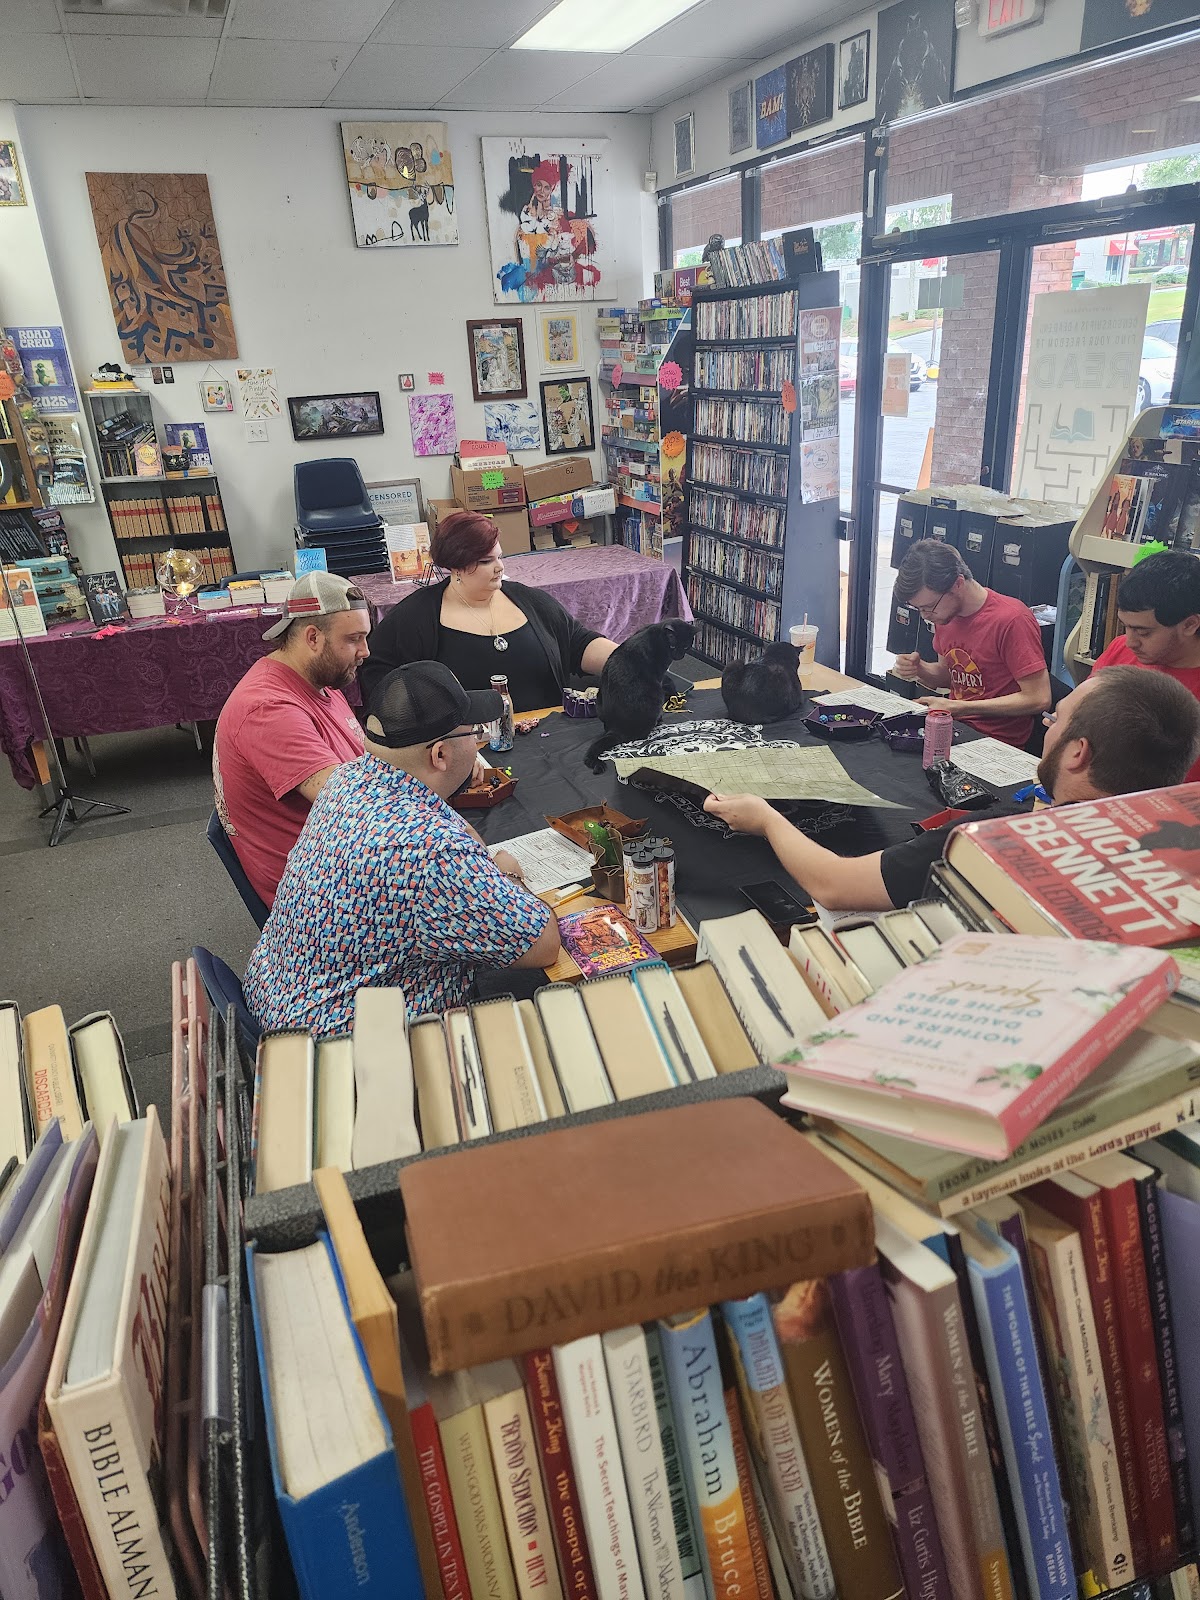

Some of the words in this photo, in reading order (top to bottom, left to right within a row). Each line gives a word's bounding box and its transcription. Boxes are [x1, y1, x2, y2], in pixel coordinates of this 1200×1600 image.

[760, 92, 784, 119] BAM!
[679, 277, 691, 287] Best
[18, 329, 51, 340] ROAD
[20, 339, 55, 349] CREW
[33, 396, 68, 407] 2025
[192, 453, 210, 461] RPG
[565, 466, 575, 475] 62
[369, 491, 413, 502] CENSORED
[300, 552, 320, 561] Bali
[300, 561, 322, 571] Blue
[949, 667, 983, 687] CAPERY
[989, 834, 1051, 882] MICHAEL
[1006, 815, 1176, 933] BENNETT
[904, 991, 961, 1006] BIBLE
[935, 979, 1057, 1010] Speak
[964, 999, 1008, 1013] THE
[1012, 1005, 1043, 1018] OF
[865, 1012, 911, 1027] AND
[893, 1003, 1022, 1030] DAUGHTERS
[914, 1020, 1023, 1046] MOTHERS
[901, 1034, 943, 1049] THE
[34, 1068, 53, 1122] DISCARDED
[938, 1171, 970, 1194] FROM
[1029, 1129, 1065, 1151] MOSES
[961, 1195, 970, 1206] a
[972, 1177, 1017, 1202] layman
[1019, 1163, 1051, 1184] looks
[1053, 1158, 1065, 1171] at
[1066, 1150, 1085, 1166] the
[1088, 1137, 1124, 1158] Lord's
[1124, 1121, 1162, 1147] prayer
[1146, 1202, 1161, 1264] GOSPEL
[503, 1267, 643, 1334] DAVID
[654, 1260, 700, 1297] the
[711, 1224, 817, 1283] KING
[1096, 1251, 1110, 1284] King
[1002, 1285, 1011, 1307] THE
[1155, 1280, 1168, 1321] MARY
[944, 1302, 963, 1370] WOMEN
[1006, 1309, 1022, 1355] WOMEN
[748, 1329, 781, 1402] DAUGHTERS
[1014, 1355, 1025, 1372] OF
[1079, 1323, 1094, 1377] MAGDALENE
[876, 1354, 893, 1398] Mary
[952, 1369, 966, 1386] of
[1018, 1373, 1029, 1398] THE
[1161, 1326, 1179, 1418] MAGDALENE
[534, 1352, 551, 1401] Karen
[545, 1418, 563, 1455] King
[623, 1354, 653, 1454] STARBIRD
[765, 1402, 785, 1422] OF
[813, 1360, 843, 1447] WOMEN
[957, 1387, 969, 1409] the
[1022, 1398, 1038, 1433] BIBLE
[501, 1413, 526, 1470] BEYOND
[595, 1434, 605, 1459] The
[770, 1421, 794, 1446] THE
[961, 1409, 980, 1459] BIBLE
[1024, 1431, 1044, 1464] Speak
[420, 1445, 434, 1481] THE
[459, 1431, 474, 1473] WHEN
[829, 1447, 848, 1470] of
[598, 1459, 609, 1500] Secret
[642, 1466, 658, 1494] The
[682, 1344, 724, 1498] Abraham
[714, 1508, 742, 1597] Bruce
[777, 1447, 804, 1493] DESERT
[837, 1467, 852, 1491] the
[467, 1473, 482, 1507] GOD
[508, 1467, 539, 1539] SEDUCTION
[83, 1421, 131, 1503] BIBLE
[107, 1505, 160, 1600] ALMAN
[427, 1480, 449, 1542] GOSPEL
[473, 1506, 488, 1535] WAS
[648, 1488, 663, 1548] Woman
[665, 1456, 681, 1487] THAN
[676, 1532, 694, 1560] WAY
[733, 1444, 757, 1523] CHARACTERS
[748, 1524, 770, 1600] DRAMATIZED
[843, 1490, 868, 1550] BIBLE
[907, 1504, 923, 1528] Liz
[339, 1502, 370, 1586] Anderson
[603, 1498, 622, 1558] Teachings
[439, 1541, 453, 1559] IN
[615, 1558, 625, 1571] of
[912, 1527, 931, 1570] Curtis
[1054, 1540, 1069, 1587] SHANNON
[443, 1558, 459, 1592] TEN
[481, 1541, 501, 1595] WOMAN
[525, 1553, 548, 1589] HUNT
[1045, 1553, 1058, 1586] BREAM
[617, 1571, 631, 1600] Mary
